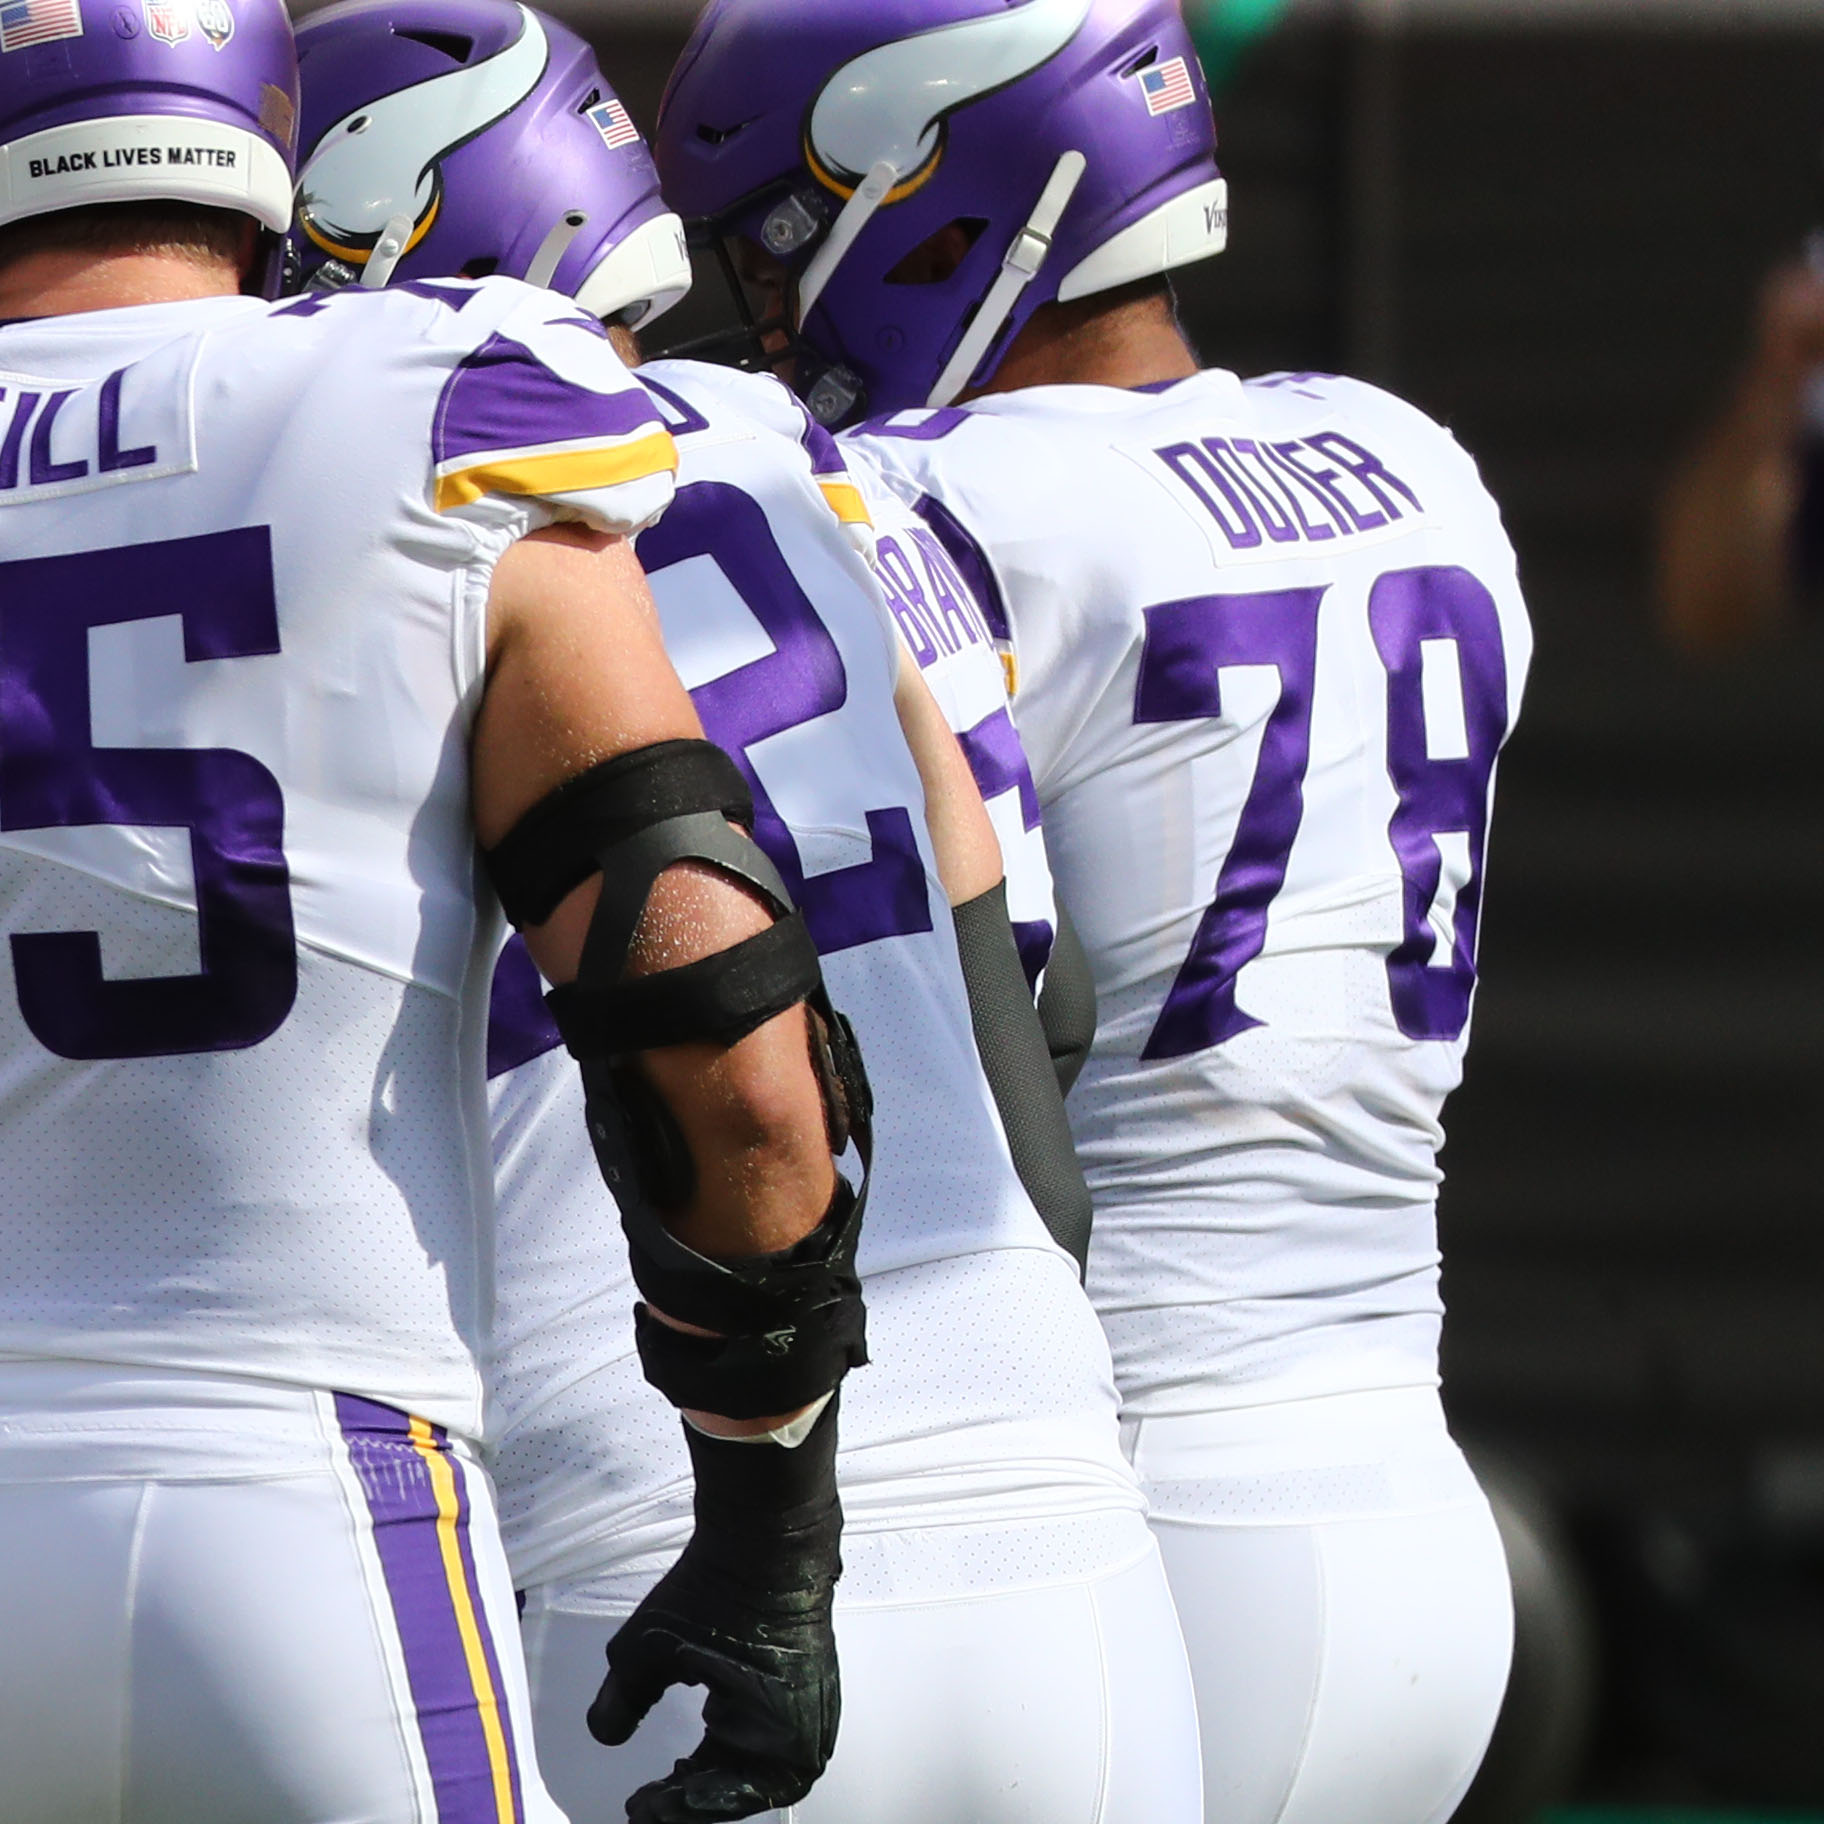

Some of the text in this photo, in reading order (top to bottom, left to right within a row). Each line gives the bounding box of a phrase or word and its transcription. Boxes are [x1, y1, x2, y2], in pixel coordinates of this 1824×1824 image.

[29, 147, 236, 178] BLACK LIVES MATTER
[1152, 431, 1425, 549] DOZIER
[1134, 564, 1509, 1062] 78
